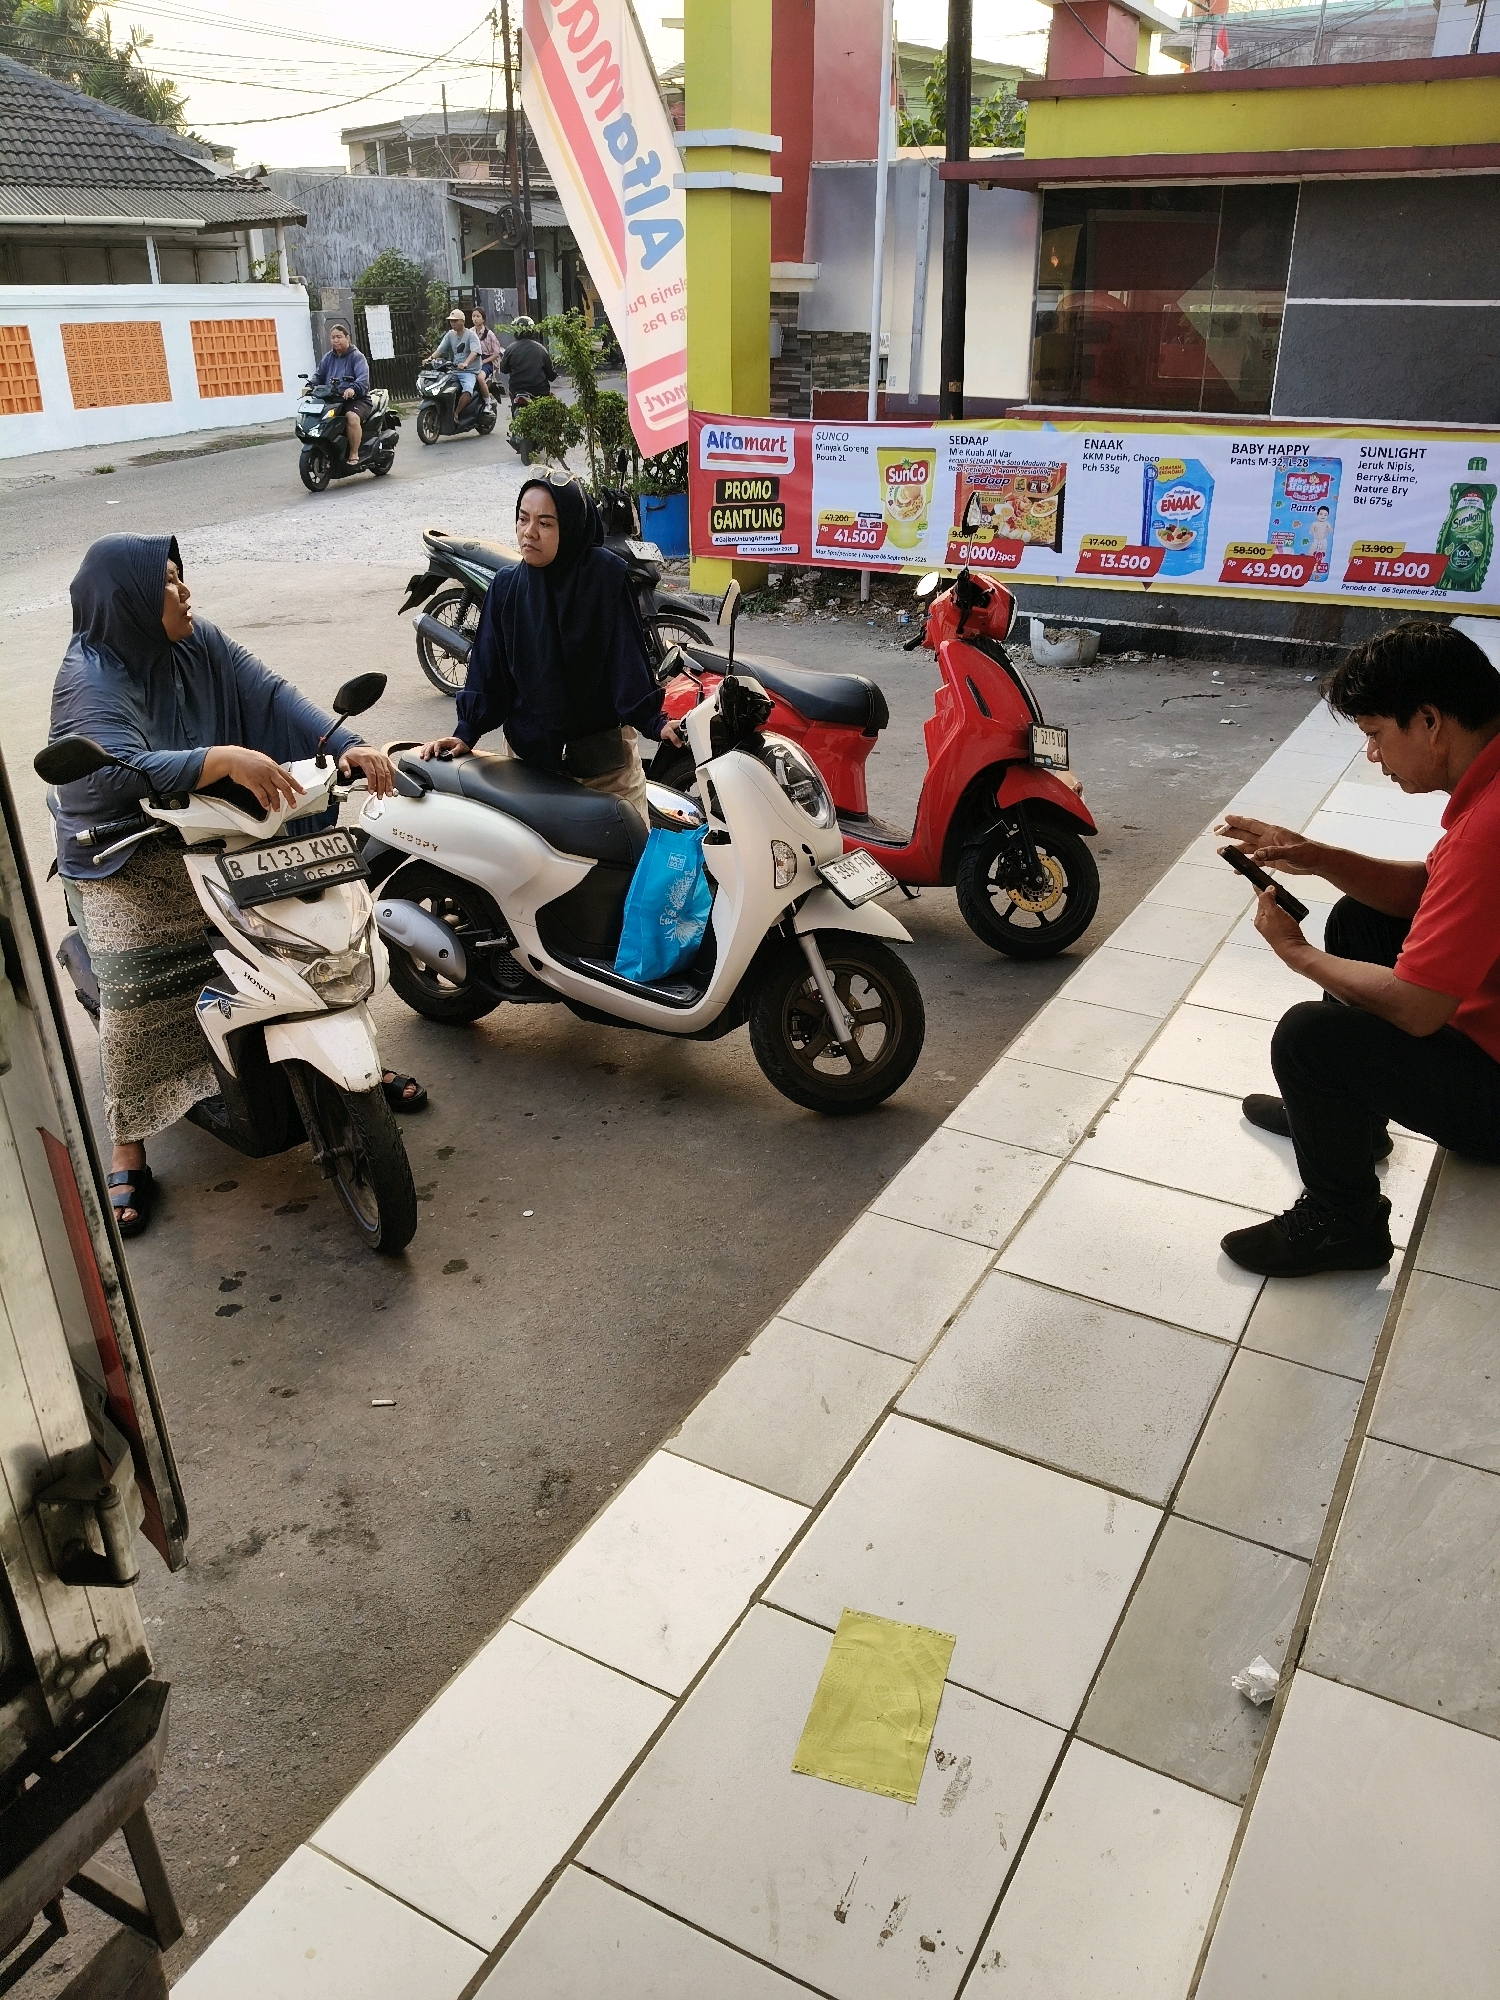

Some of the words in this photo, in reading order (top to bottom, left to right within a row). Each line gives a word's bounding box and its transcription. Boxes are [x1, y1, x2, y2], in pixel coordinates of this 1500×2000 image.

[707, 430, 787, 453] Alfamart
[815, 431, 850, 442] SUNCO
[949, 435, 989, 446] SEDAAP
[815, 443, 842, 453] Minyak
[843, 444, 869, 454] Goreng
[1083, 438, 1124, 450] ENAAK
[1231, 443, 1265, 455] BABY
[1267, 444, 1310, 456] HAPPY
[838, 454, 847, 462] 2L
[949, 447, 964, 456] Mie
[965, 448, 985, 457] Kuah
[999, 450, 1013, 458] Var
[1082, 452, 1104, 461] KKM
[1105, 453, 1131, 463] Putih,
[1133, 453, 1160, 463] Choco
[1359, 446, 1427, 459] SUNLIGHT
[1230, 457, 1256, 466] Pants
[1288, 458, 1309, 467] L-28
[1357, 460, 1384, 470] Jeruk
[1386, 461, 1415, 472] Nipis,
[888, 463, 926, 483] SunCo
[1082, 463, 1098, 472] Pch
[1099, 463, 1120, 475] 535g
[1356, 472, 1418, 484] Berry&Lime,
[724, 480, 772, 500] PROMO
[1354, 484, 1389, 494] Nature
[1391, 485, 1409, 497] Bry
[1160, 494, 1202, 513] ENAAK
[1290, 503, 1317, 512] Pants
[1353, 495, 1367, 505] Btl
[1369, 496, 1393, 508] 675g
[713, 507, 783, 530] GANTUNG
[1451, 512, 1484, 530] Sunlight
[833, 528, 877, 544] 41.500
[1089, 538, 1118, 547] 17.400
[959, 544, 1017, 562] 8000/3pcs
[1233, 546, 1266, 556] 58.500
[1361, 544, 1394, 554] 13.900
[1082, 551, 1092, 559] Rp
[1100, 553, 1151, 570] 13.500
[1227, 559, 1237, 567] Rp
[1241, 562, 1304, 580] 49.900
[1353, 558, 1363, 566] Rp
[1373, 561, 1430, 579] 11.900
[1340, 583, 1367, 592] Periode
[1391, 587, 1429, 597] September
[1429, 589, 1448, 597] 2026
[228, 859, 245, 879] B
[257, 846, 305, 872] 4133
[308, 836, 349, 859] KNG
[243, 971, 277, 1001] HONDA
